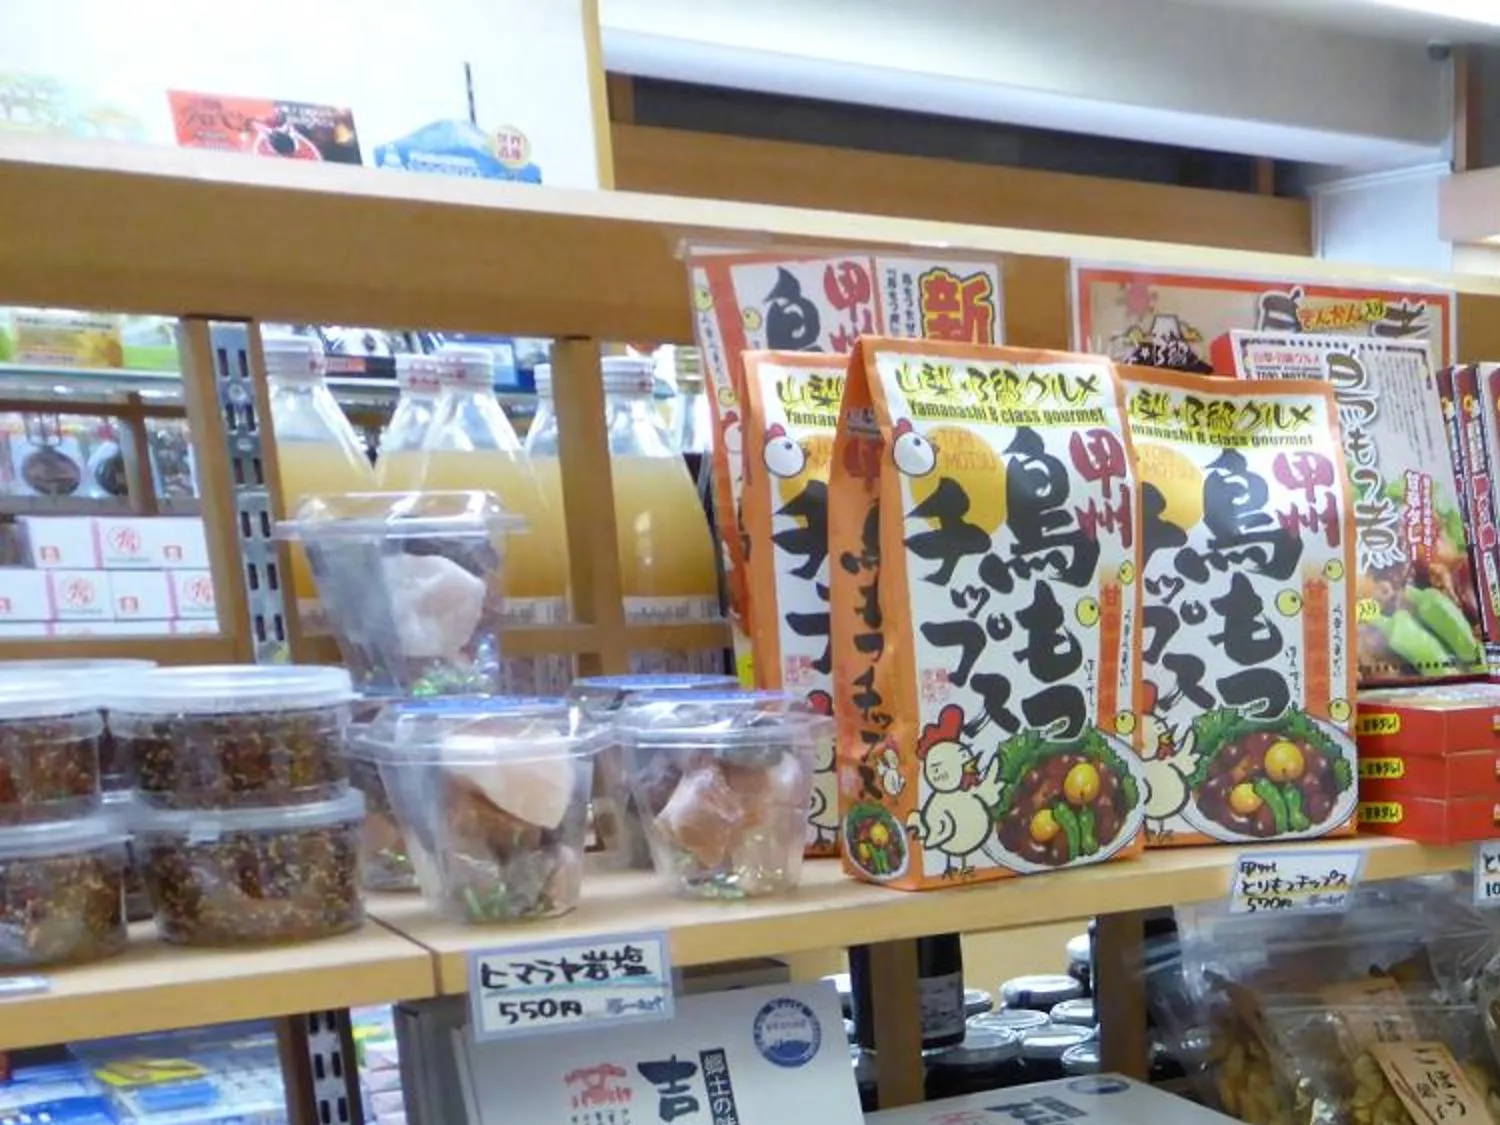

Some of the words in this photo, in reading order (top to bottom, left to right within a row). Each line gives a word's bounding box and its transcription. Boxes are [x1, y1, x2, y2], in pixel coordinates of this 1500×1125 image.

[1001, 407, 1041, 424] class
[1042, 406, 1105, 424] gourmet
[1251, 432, 1314, 451] gourmet
[1069, 428, 1133, 549] 甲州
[1272, 450, 1341, 550] 甲州
[481, 945, 651, 989] ヒマラヤ岩塩
[499, 999, 583, 1025] 550円
